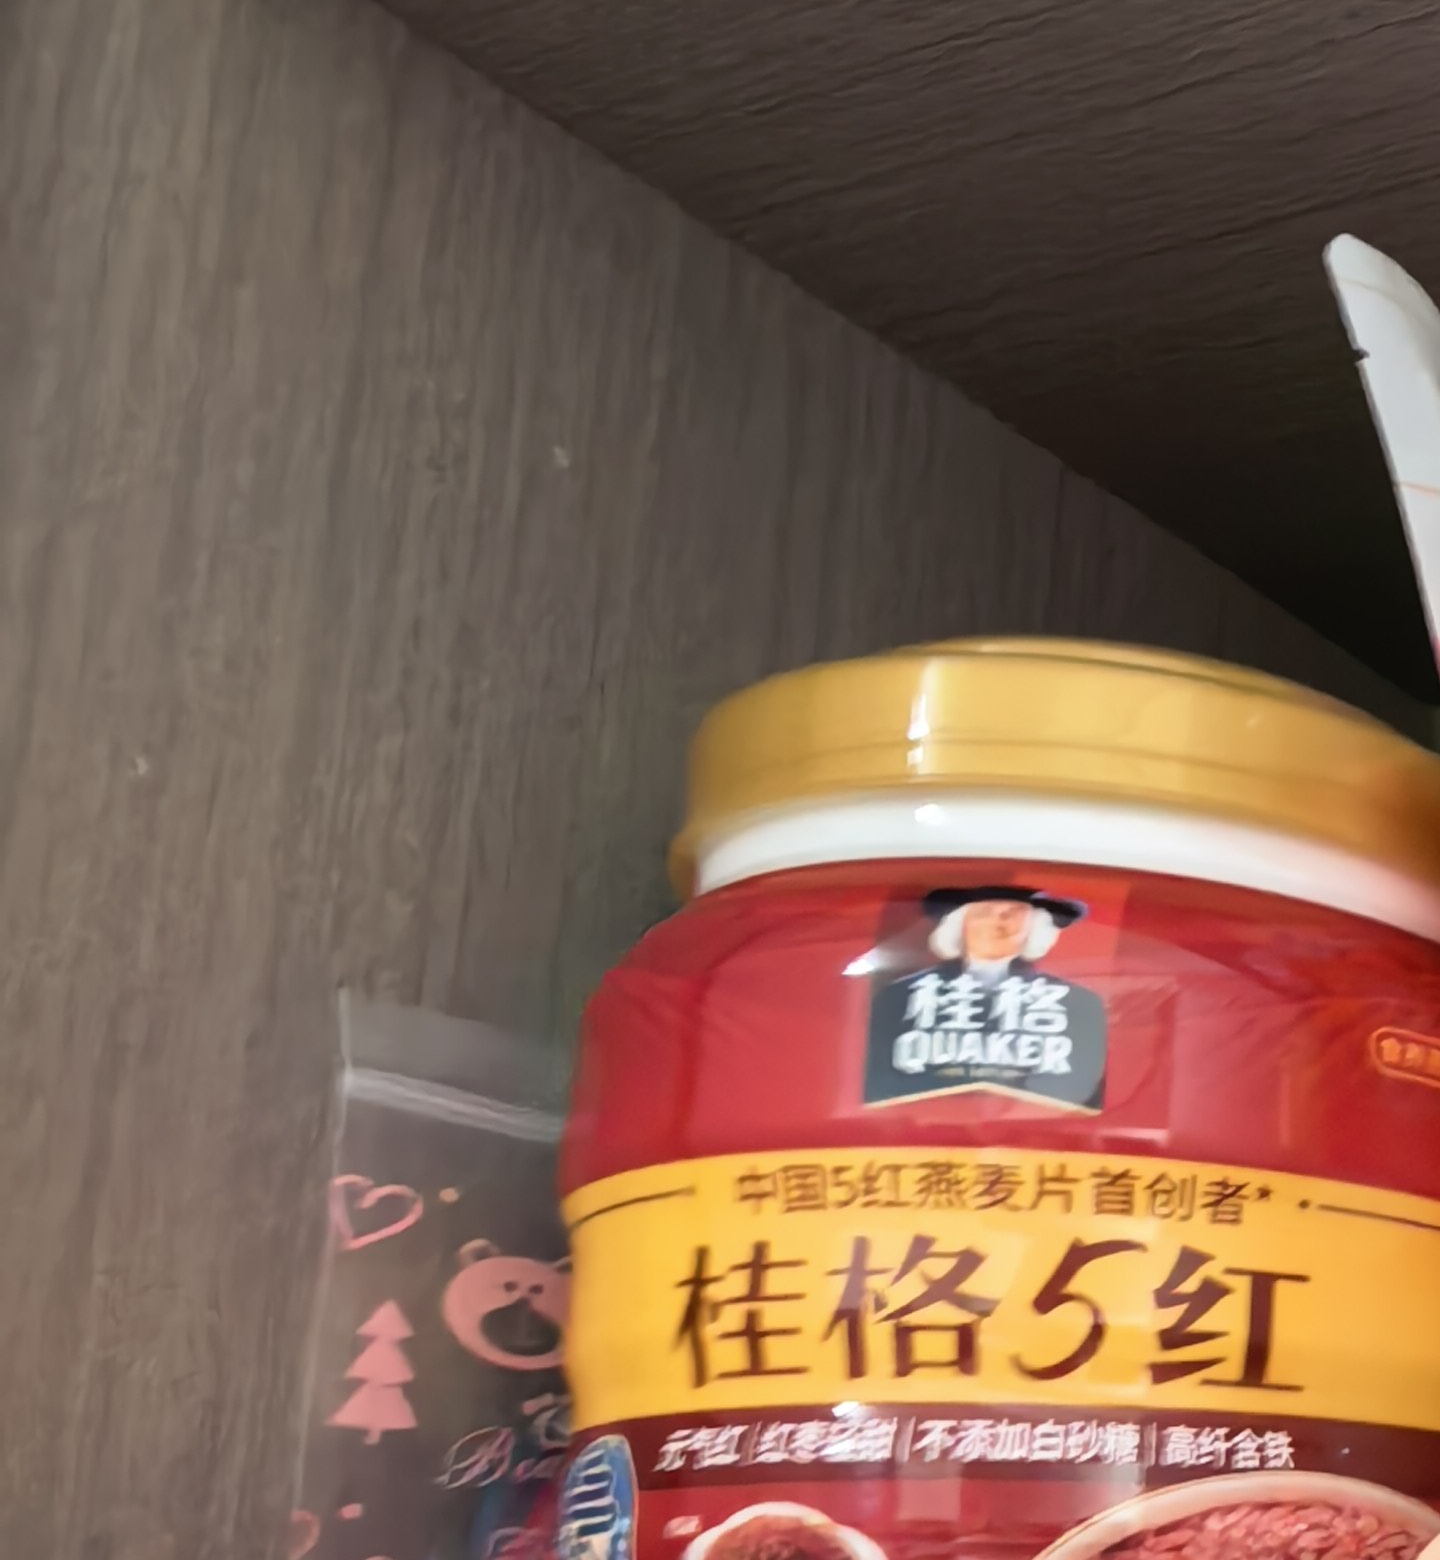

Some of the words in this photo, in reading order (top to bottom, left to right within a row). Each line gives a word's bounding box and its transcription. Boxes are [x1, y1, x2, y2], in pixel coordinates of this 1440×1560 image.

[903, 973, 1071, 1034] 桂格
[892, 1030, 1073, 1075] QUAKER
[670, 1235, 1312, 1395] 桂格5红
[914, 1416, 1142, 1463] 不添加白砂糖
